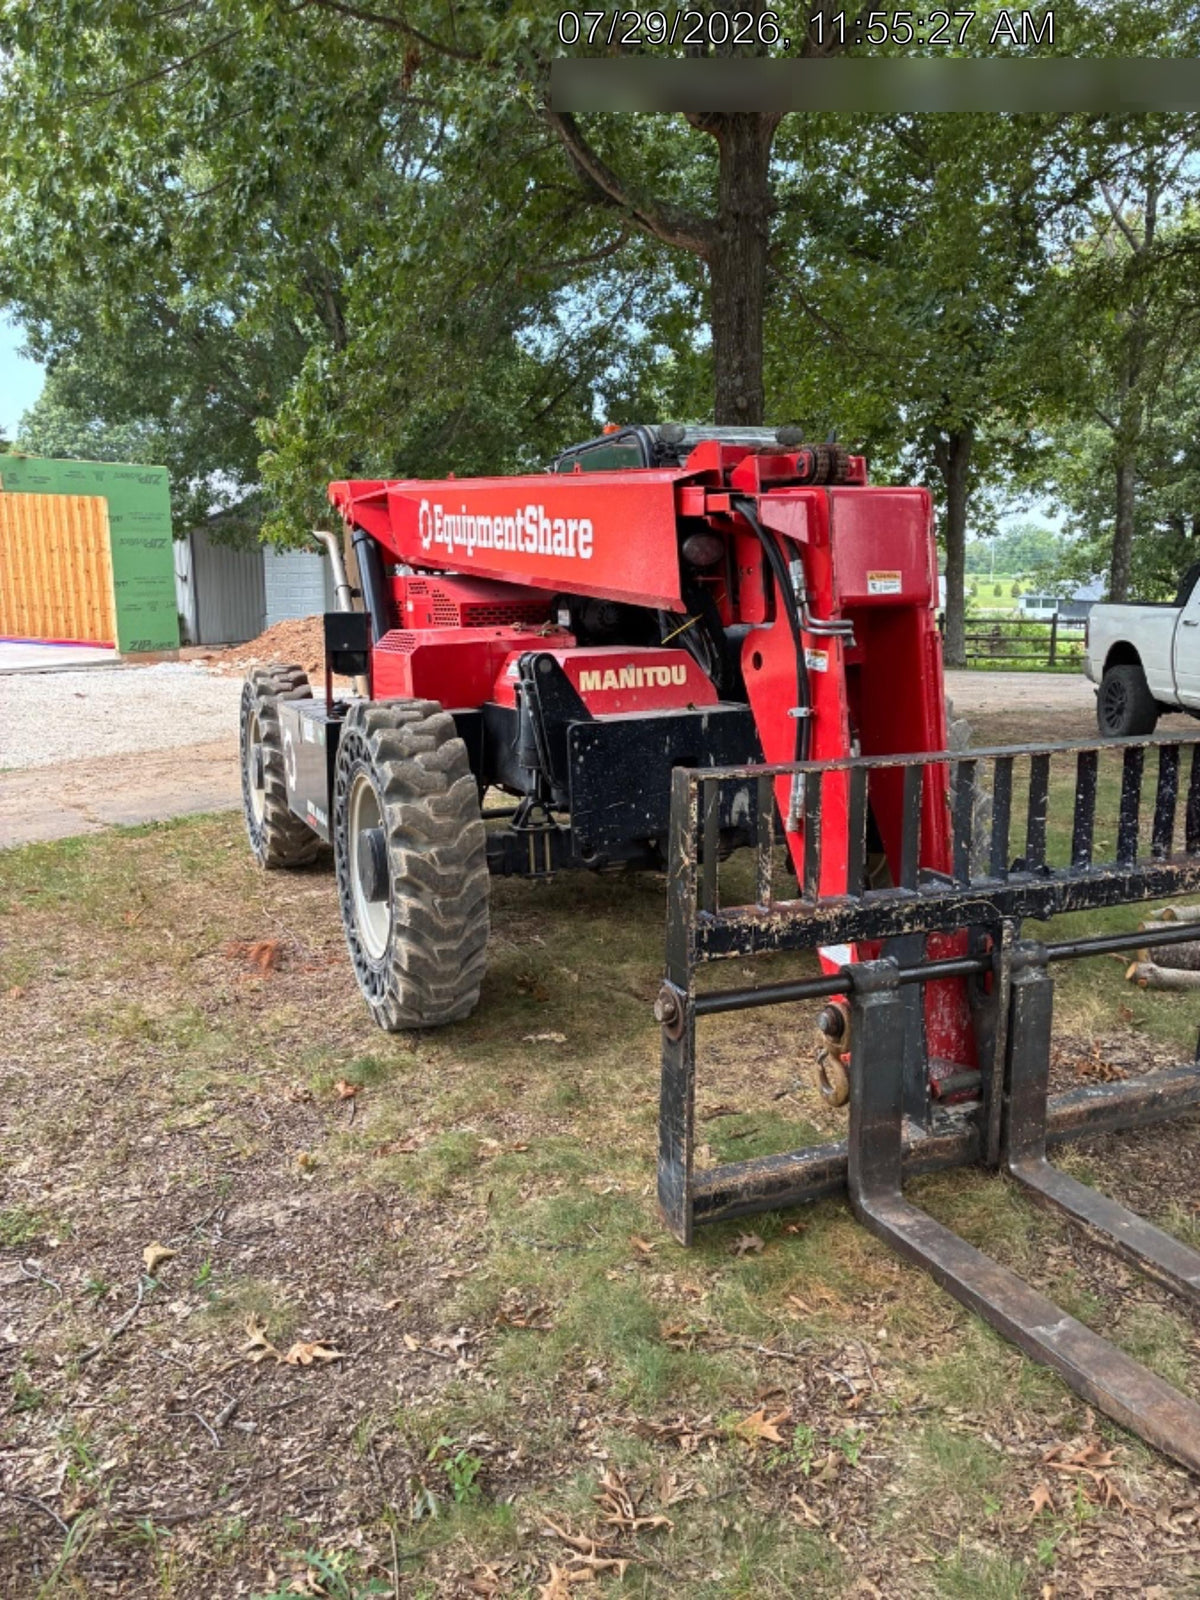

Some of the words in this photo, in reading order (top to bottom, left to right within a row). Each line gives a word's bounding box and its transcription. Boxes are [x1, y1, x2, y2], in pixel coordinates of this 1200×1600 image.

[433, 504, 593, 559] EquipmentShare
[128, 640, 152, 651] ZIP
[579, 664, 688, 692] MANITOU
